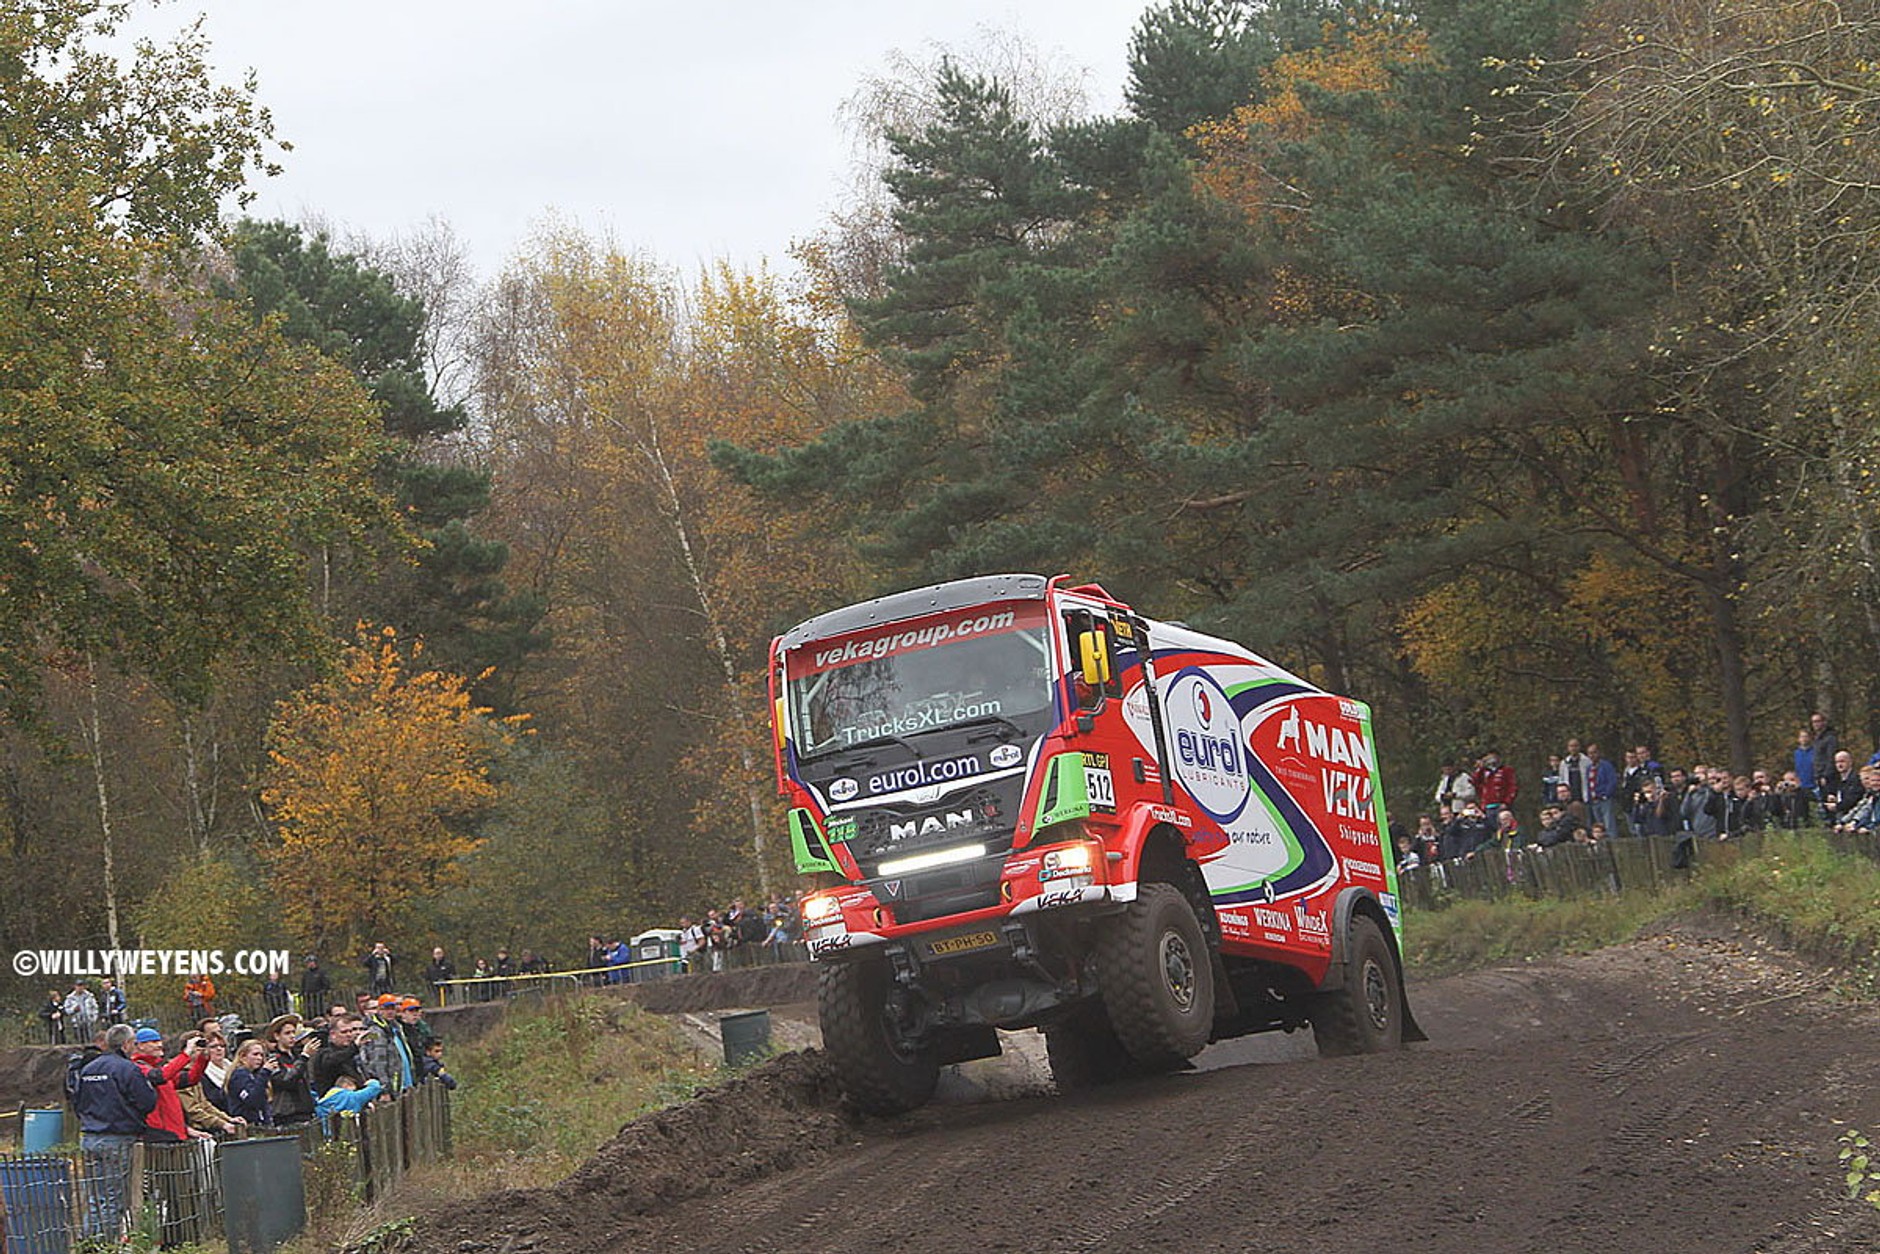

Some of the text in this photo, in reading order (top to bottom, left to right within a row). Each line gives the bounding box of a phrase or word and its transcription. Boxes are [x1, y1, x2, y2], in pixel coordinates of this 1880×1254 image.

[814, 609, 1015, 668] vekagroup.com
[842, 699, 1001, 744] TrucksXL.com
[1178, 728, 1243, 777] eurol
[1304, 719, 1374, 773] MAN
[869, 756, 980, 793] eurol.com
[1087, 772, 1112, 801] 512
[1321, 768, 1375, 823] VEKA
[890, 810, 974, 840] MAN
[1338, 823, 1379, 846] Shipyards
[934, 932, 994, 953] BT-PH-50
